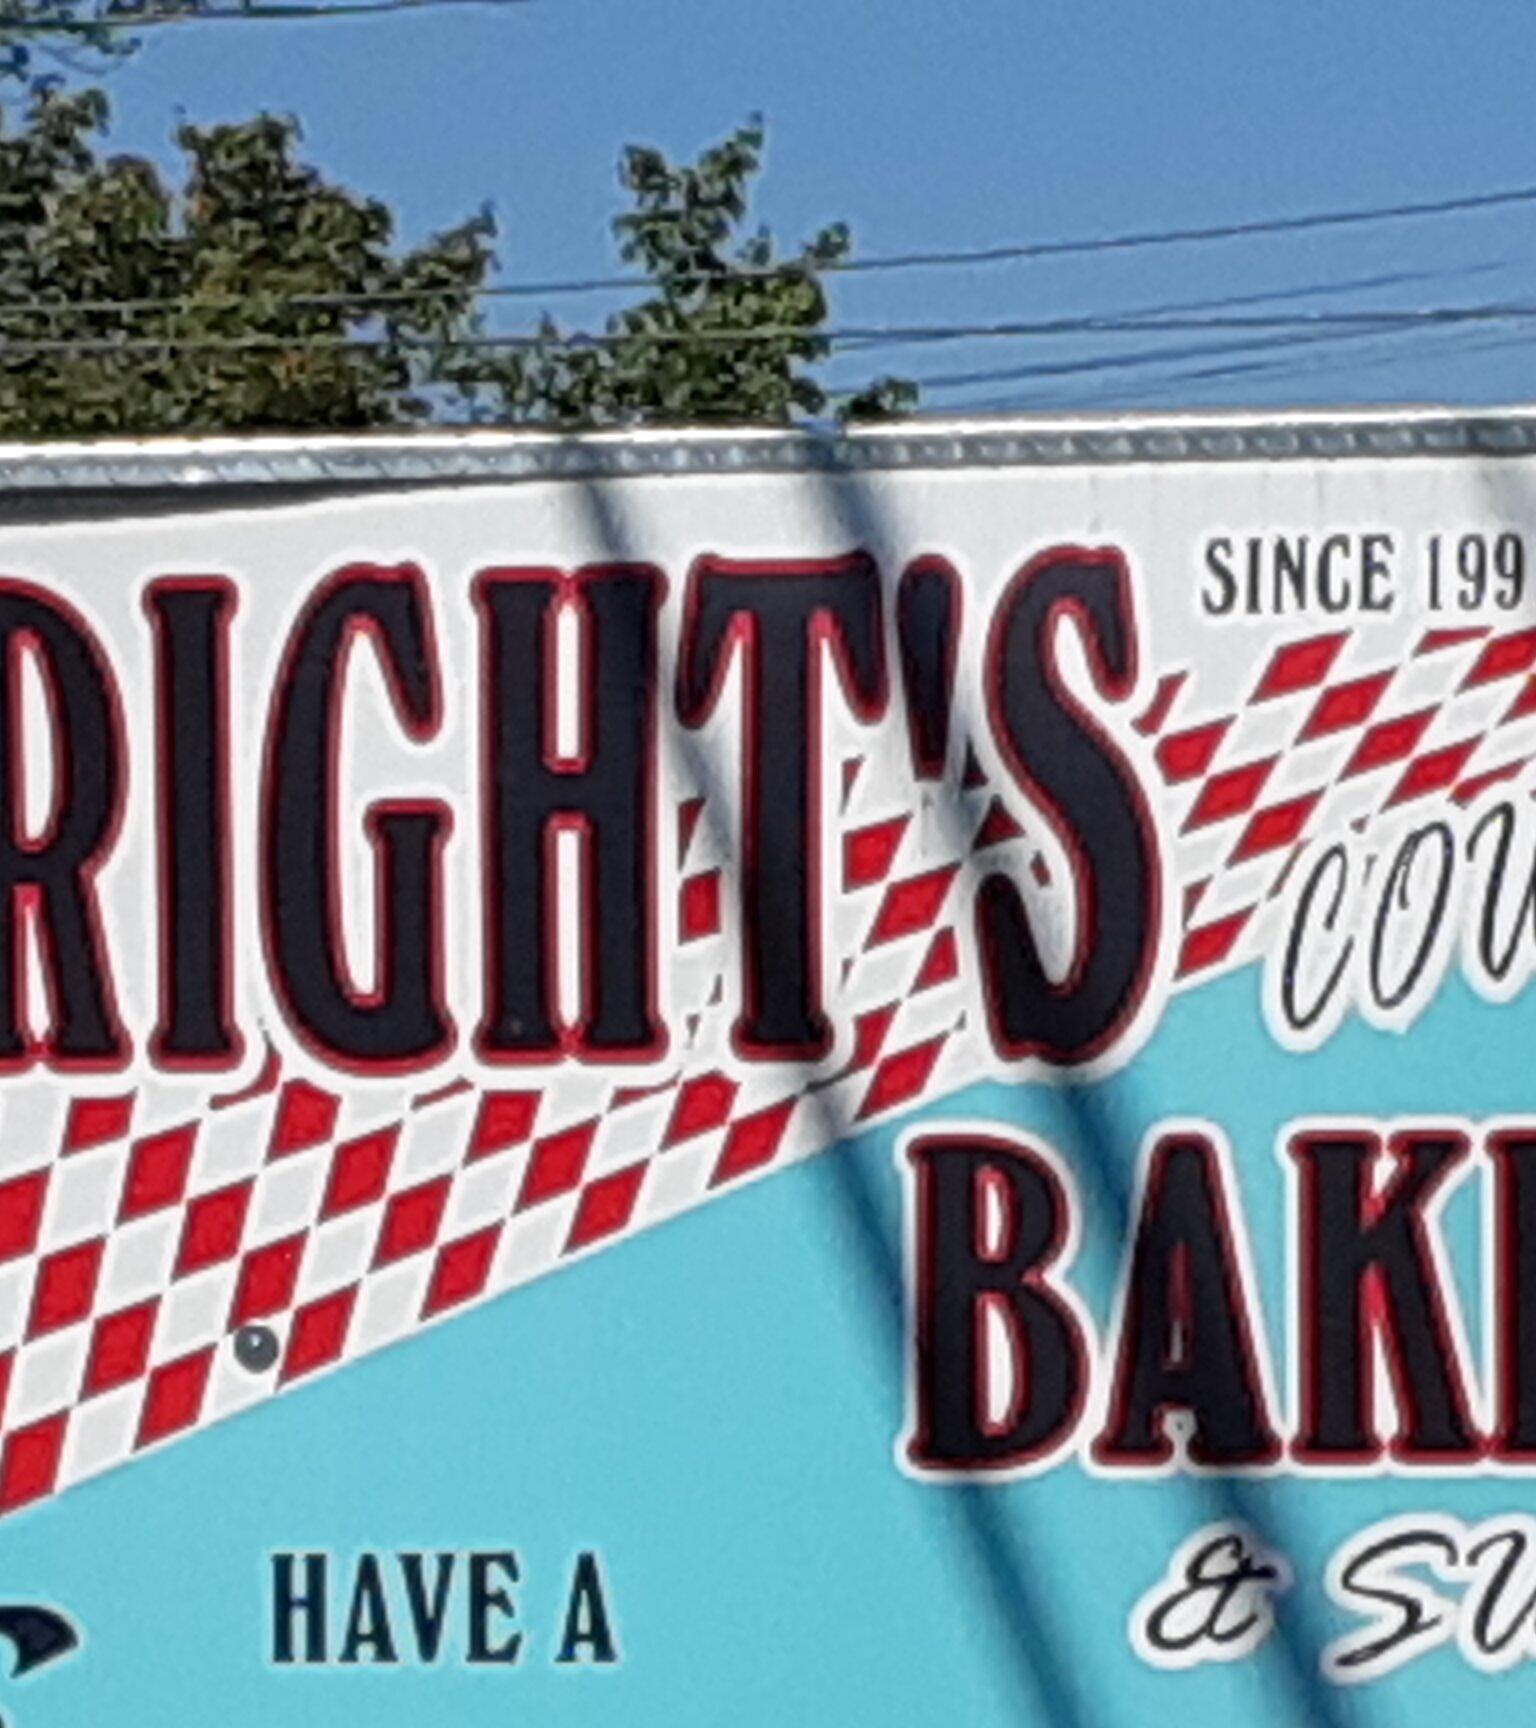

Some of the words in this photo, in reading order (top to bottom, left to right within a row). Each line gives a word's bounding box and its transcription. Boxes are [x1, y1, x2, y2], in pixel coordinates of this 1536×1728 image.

[1200, 533, 1396, 615] SINCE
[269, 1550, 523, 1665] HAVE
[555, 1550, 619, 1665] A
[1146, 1534, 1276, 1651] &
